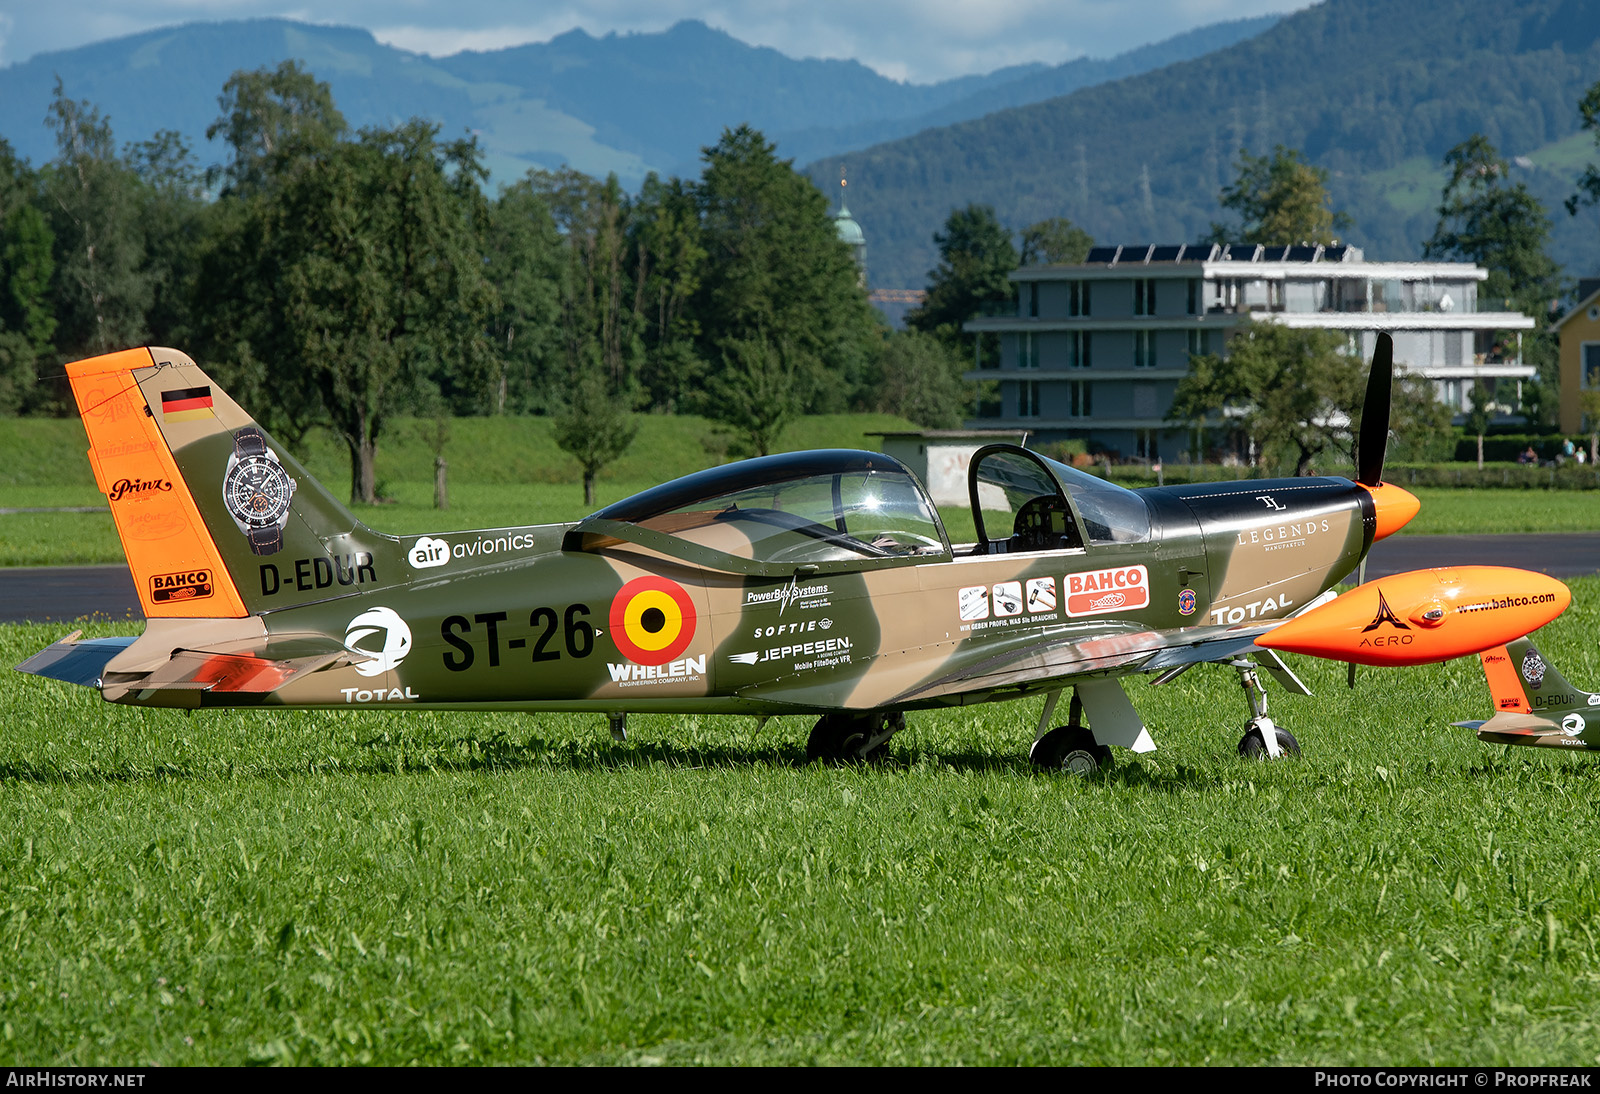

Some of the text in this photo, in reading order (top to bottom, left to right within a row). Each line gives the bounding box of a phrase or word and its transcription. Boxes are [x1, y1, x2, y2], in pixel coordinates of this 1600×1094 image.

[110, 478, 172, 501] Prinz
[1238, 519, 1330, 545] LEGENDS
[416, 533, 534, 563] air avionics
[154, 572, 208, 588] BAHCO
[259, 551, 377, 596] D-EDUR
[1069, 568, 1142, 593] BAHCO
[793, 584, 828, 598] Systems
[1211, 593, 1293, 625] TOTAL
[1457, 593, 1556, 614] www.bahco.com
[754, 620, 817, 638] SOFTIE
[972, 622, 988, 631] GEBEN
[989, 619, 1009, 628] PROFIS,
[1031, 613, 1058, 623] BRAUCHEN
[440, 603, 594, 672] ST-26
[1359, 634, 1413, 647] AERO
[607, 654, 706, 682] WHELEN
[794, 661, 813, 671] Mobile
[840, 655, 851, 664] VFR
[619, 679, 658, 688] ENGINEERING
[340, 686, 419, 704] TOTAL
[1535, 694, 1576, 706] D-EDUR
